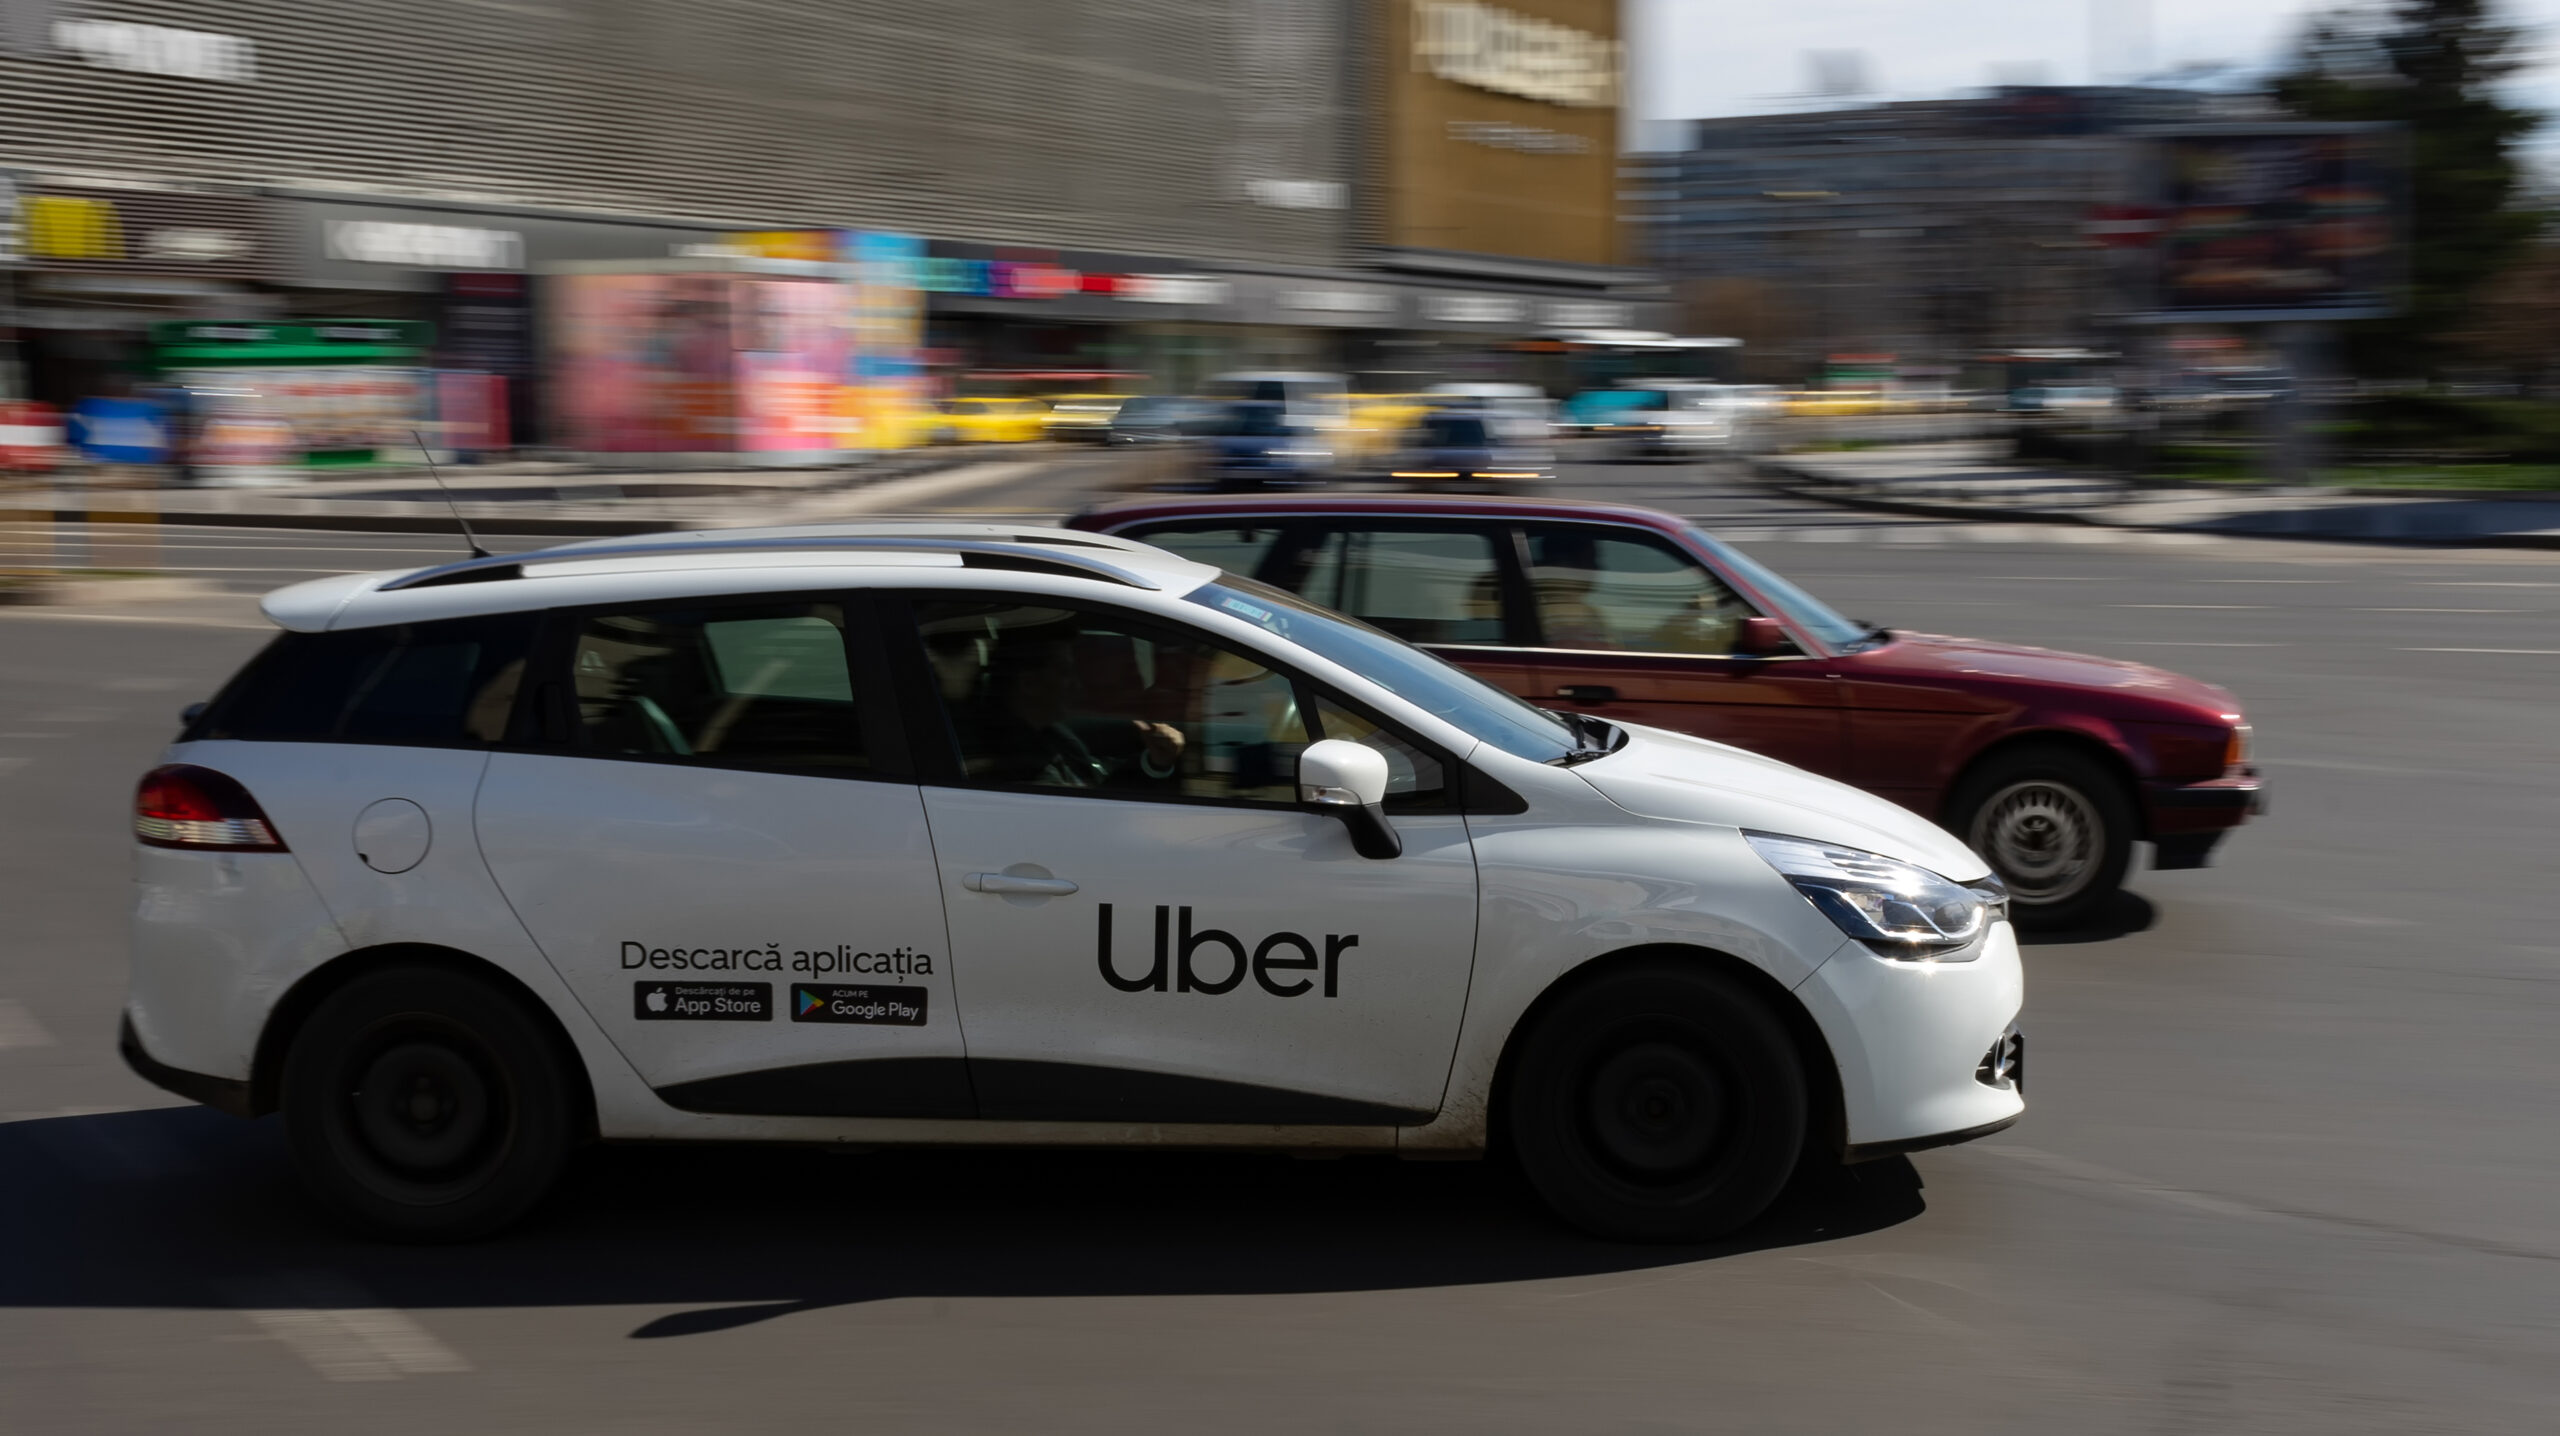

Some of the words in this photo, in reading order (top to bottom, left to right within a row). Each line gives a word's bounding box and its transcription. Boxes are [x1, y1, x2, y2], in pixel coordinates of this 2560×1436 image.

[1098, 903, 1359, 998] Uber
[621, 941, 783, 971] Descarcă
[792, 945, 934, 983] aplicația
[728, 987, 740, 996] de
[743, 988, 755, 996] pe
[832, 990, 857, 998] ACUM
[858, 990, 869, 998] PE
[674, 997, 711, 1015] App
[714, 998, 761, 1013] Store
[831, 1000, 886, 1020] Google
[888, 1002, 919, 1020] Play
